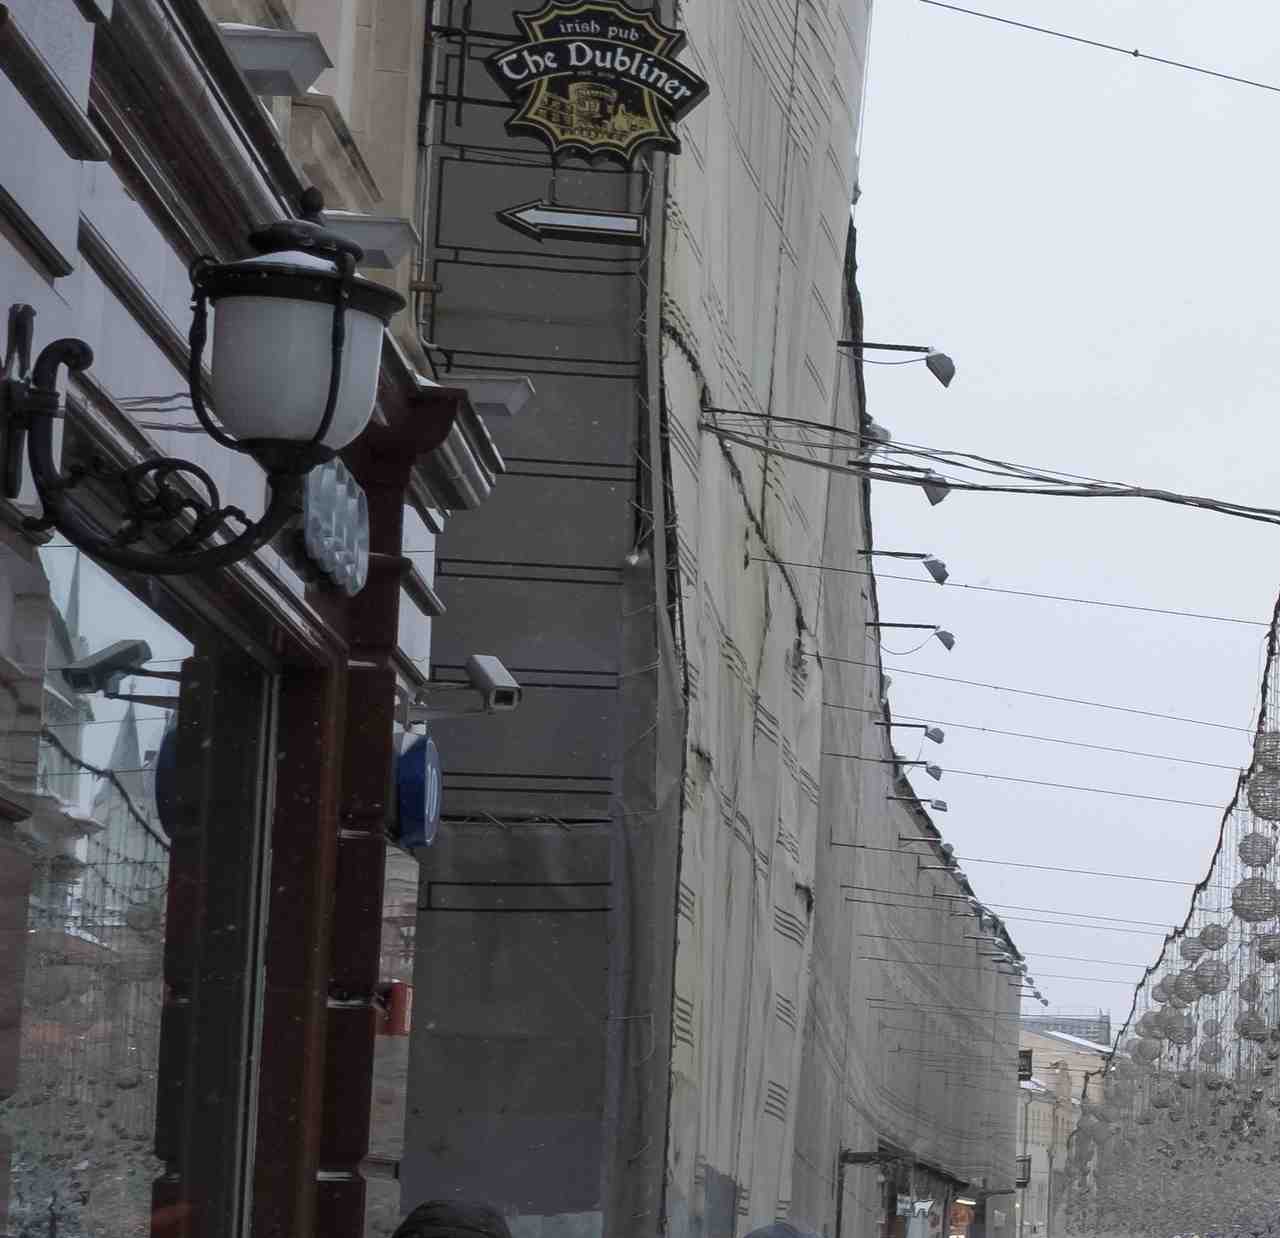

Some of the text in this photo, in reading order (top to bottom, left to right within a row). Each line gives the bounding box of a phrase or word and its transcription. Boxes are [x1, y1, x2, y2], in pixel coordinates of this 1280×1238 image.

[607, 25, 640, 42] pub
[498, 41, 693, 100] The Dubliner
